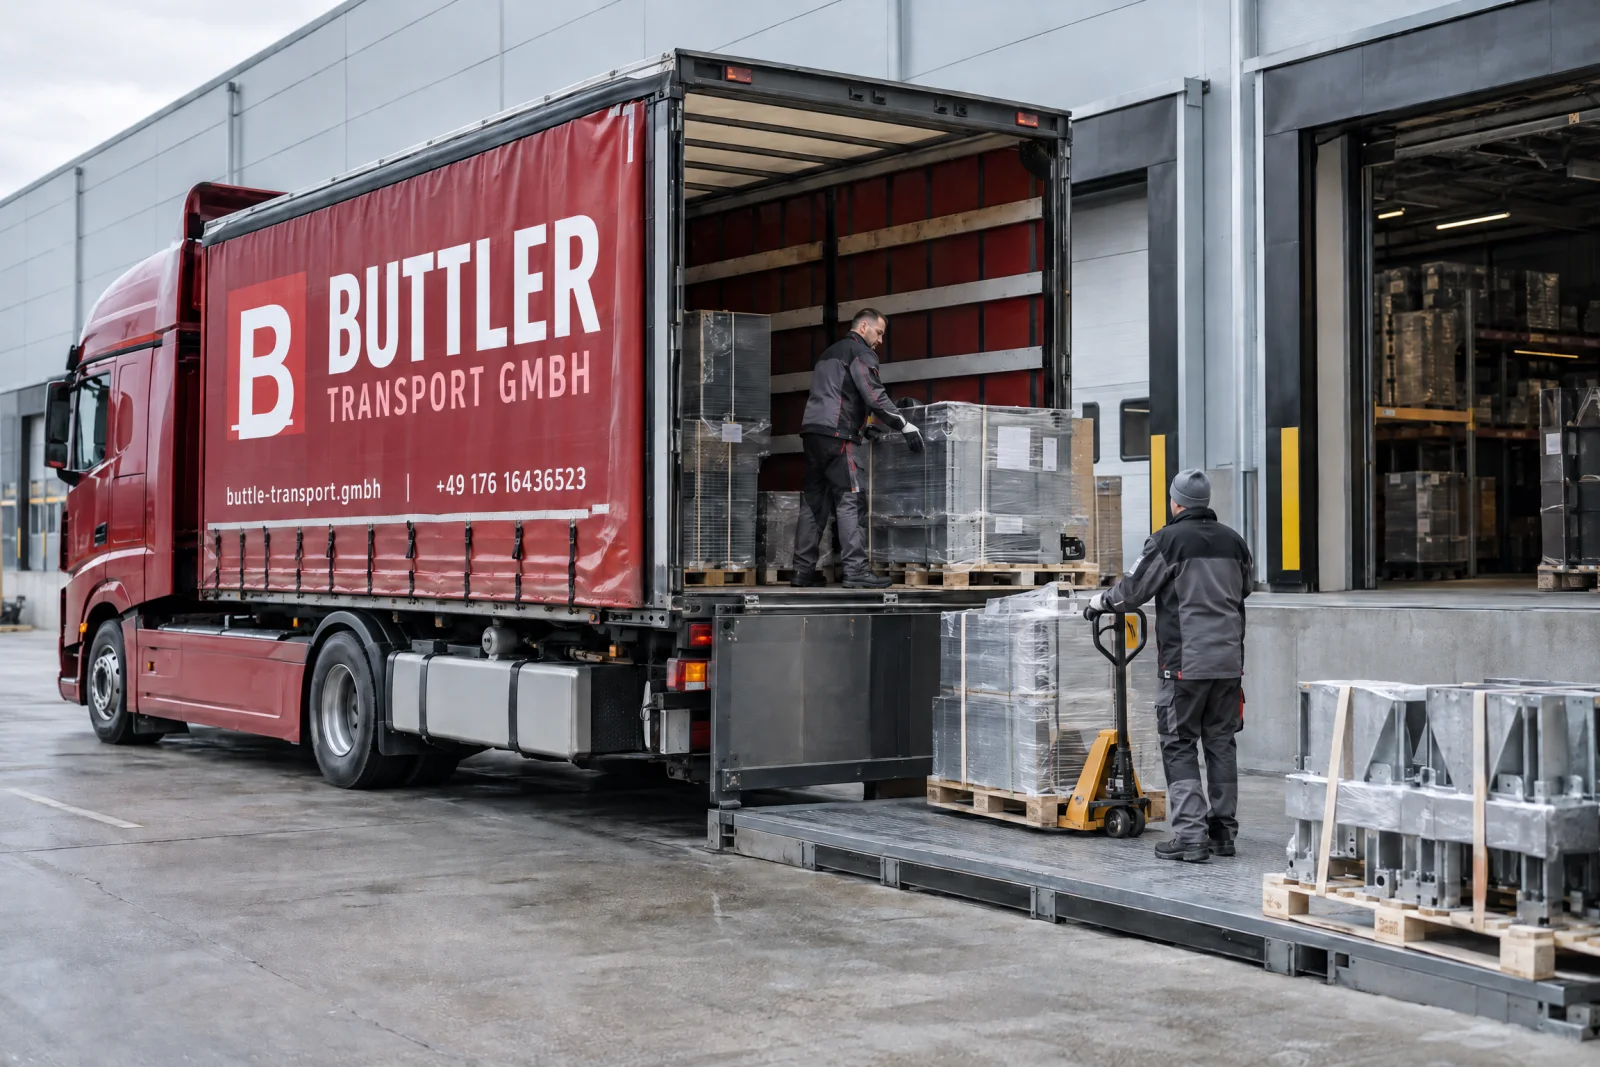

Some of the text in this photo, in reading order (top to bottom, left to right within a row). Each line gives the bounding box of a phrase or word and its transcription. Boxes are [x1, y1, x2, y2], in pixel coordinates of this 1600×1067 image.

[328, 214, 602, 376] BUTTLER
[231, 303, 295, 441] B
[327, 350, 590, 423] TRANSPORT GMBH
[226, 466, 587, 508] buttle-transport.gmbh +49 176 16436523
